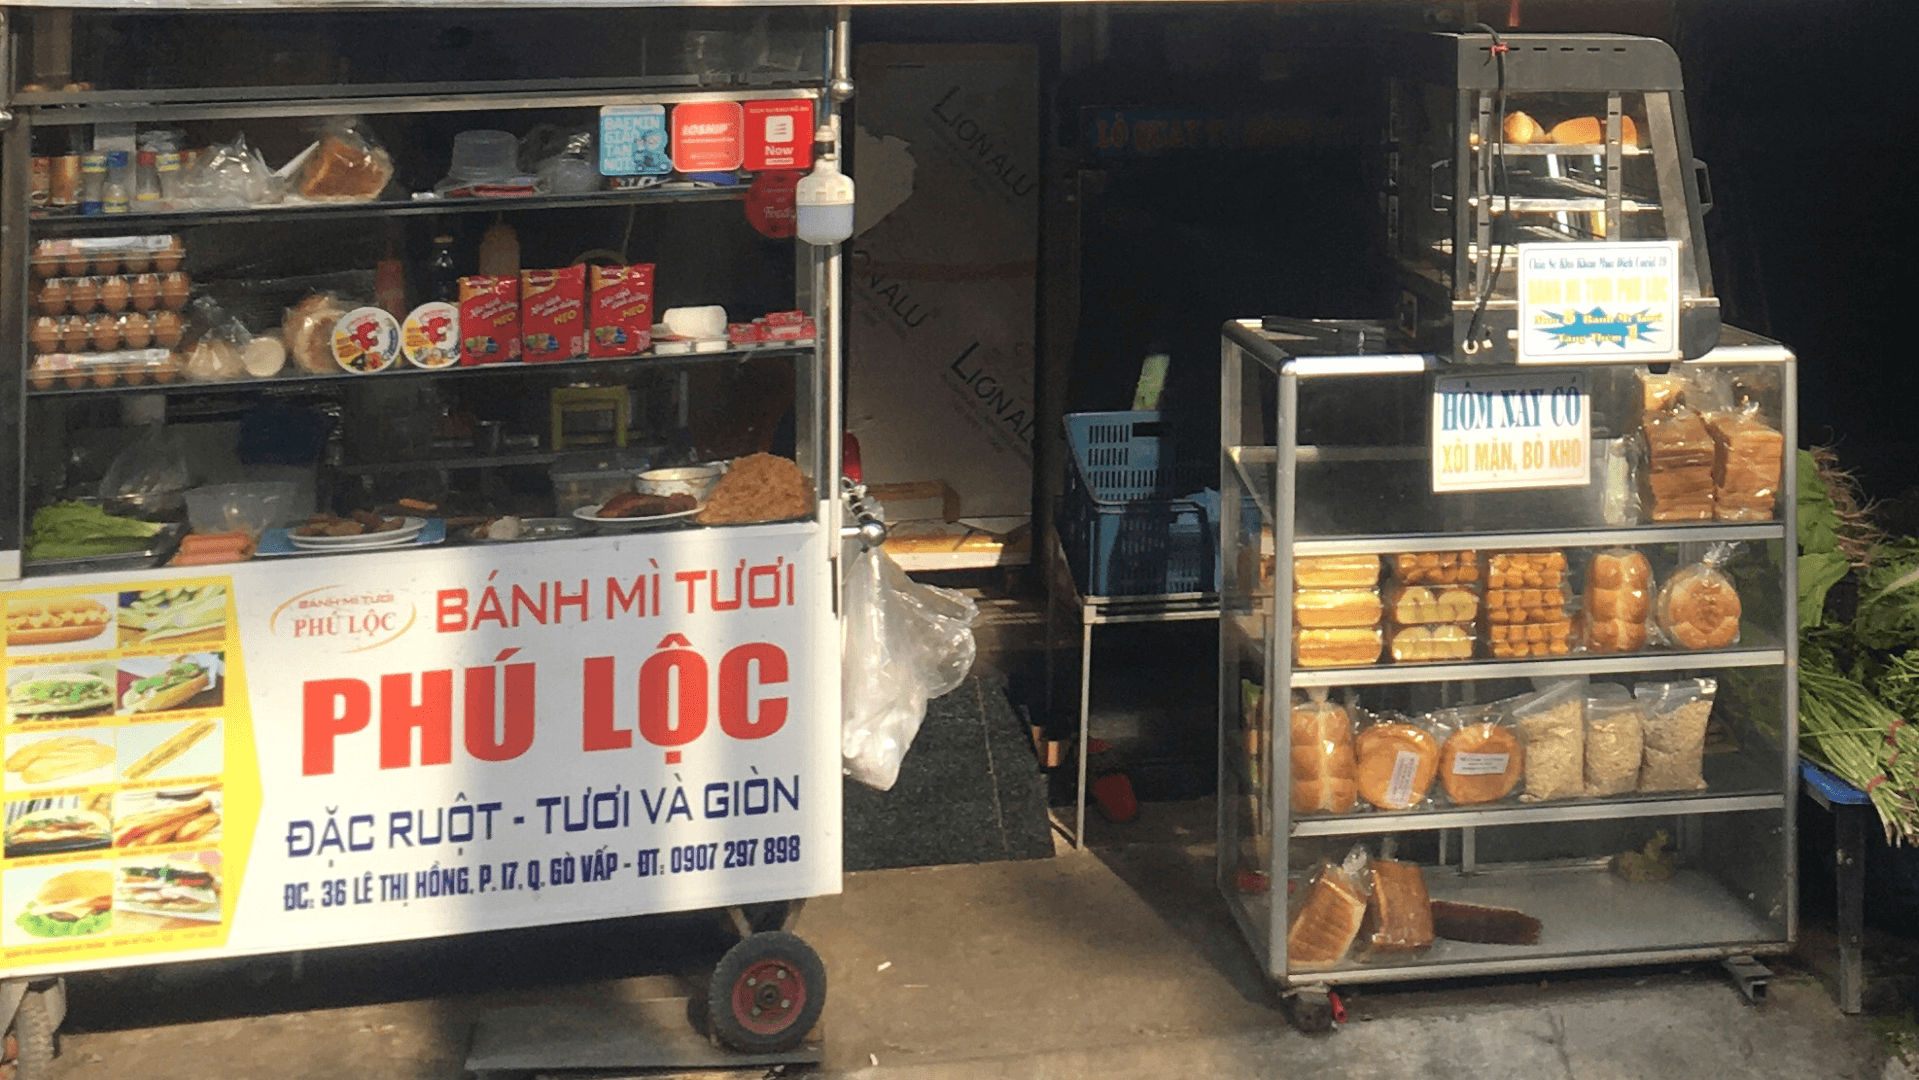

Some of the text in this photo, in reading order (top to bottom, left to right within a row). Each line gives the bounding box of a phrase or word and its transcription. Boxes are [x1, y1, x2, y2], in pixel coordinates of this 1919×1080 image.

[765, 145, 794, 156] Now
[931, 86, 1036, 197] LIONALU
[1442, 376, 1581, 432] HÔM NAY CÓ
[1442, 437, 1470, 474] XÔI
[1522, 433, 1544, 469] BÒ
[1549, 437, 1582, 470] KHO
[294, 608, 397, 638] PHÚ LỘC
[435, 555, 795, 635] BÁNH MÌ TƯƠI
[301, 632, 790, 777] PHÚ LỘC
[285, 765, 801, 867] ĐẶC RUỘT - TƯƠI VÀ GIÒN
[284, 882, 314, 912] ĐC:
[321, 878, 347, 908] 36
[353, 870, 374, 905] LÊ
[378, 872, 409, 908] THỊ
[479, 864, 498, 894] P.
[527, 860, 546, 891] Q.
[550, 851, 576, 886] GÒ
[580, 844, 618, 883] VẤP
[637, 848, 665, 878] ĐT:
[670, 842, 718, 874] 0907
[723, 838, 759, 869] 297
[763, 834, 801, 865] 898
